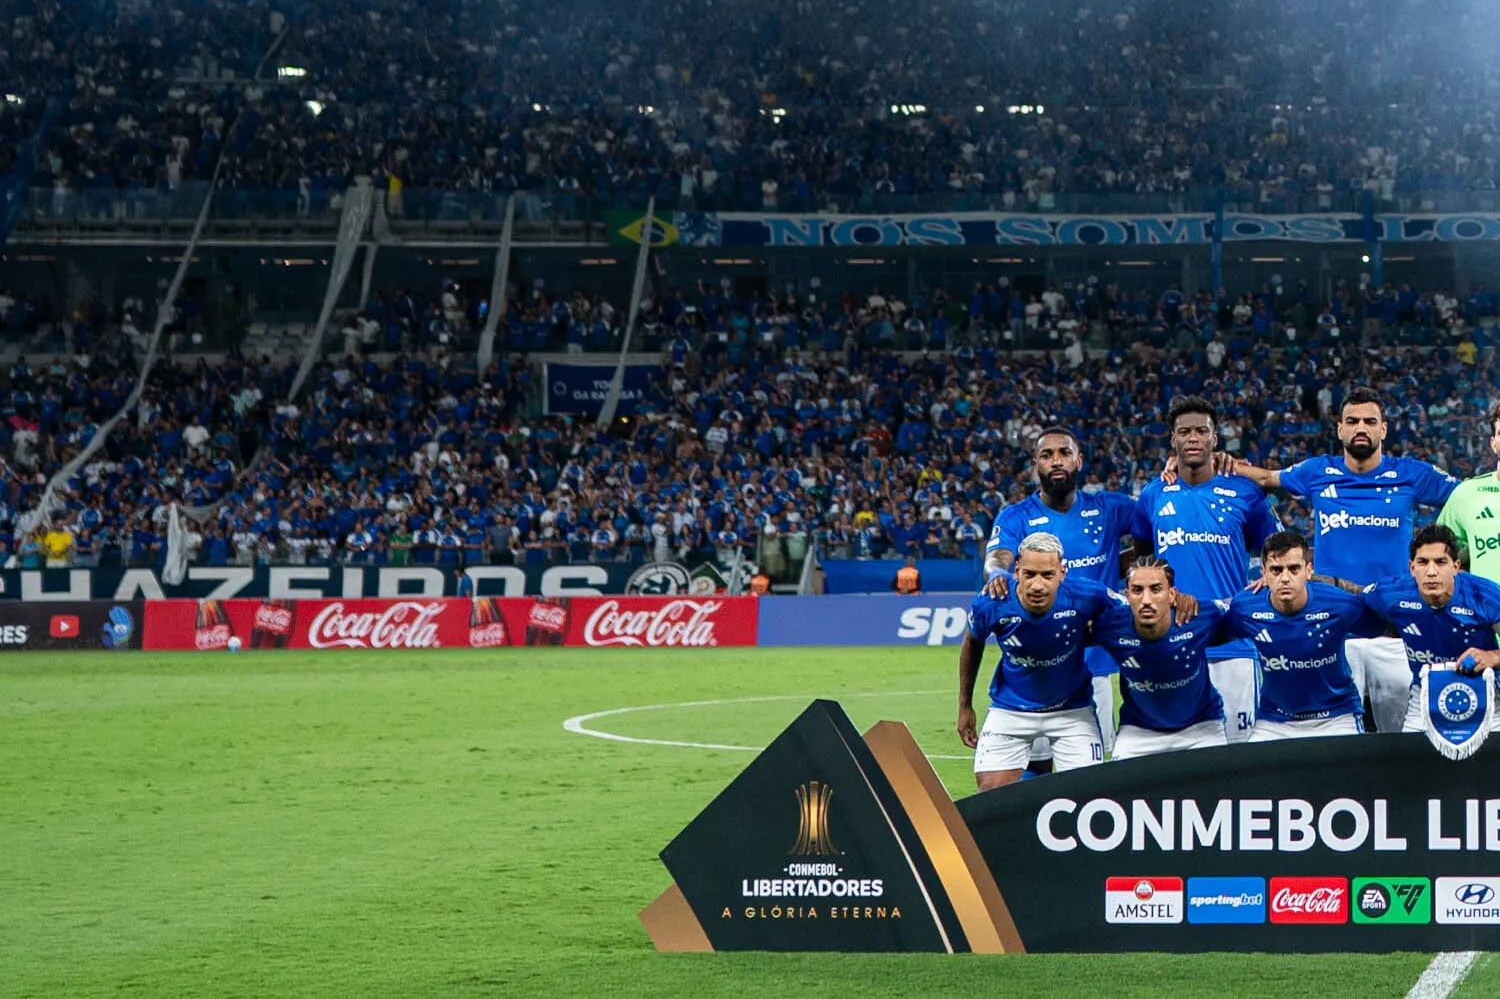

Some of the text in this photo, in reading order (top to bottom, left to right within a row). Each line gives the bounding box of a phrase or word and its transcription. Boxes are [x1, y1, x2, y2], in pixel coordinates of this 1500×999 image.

[995, 216, 1346, 245] SOMOS
[308, 602, 447, 649] Coca-Cola
[584, 600, 723, 647] Coca-Cola
[1090, 742, 1102, 761] 10
[1036, 798, 1407, 851] CONMEBOL
[742, 879, 883, 897] LIBERTADORES
[1190, 892, 1263, 908] sportingbet
[1272, 888, 1344, 913] Coca-Cola
[1362, 901, 1386, 909] SPORTS
[721, 904, 902, 919] A GLÓRIA ETERNA
[1115, 904, 1174, 918] AMSTEL
